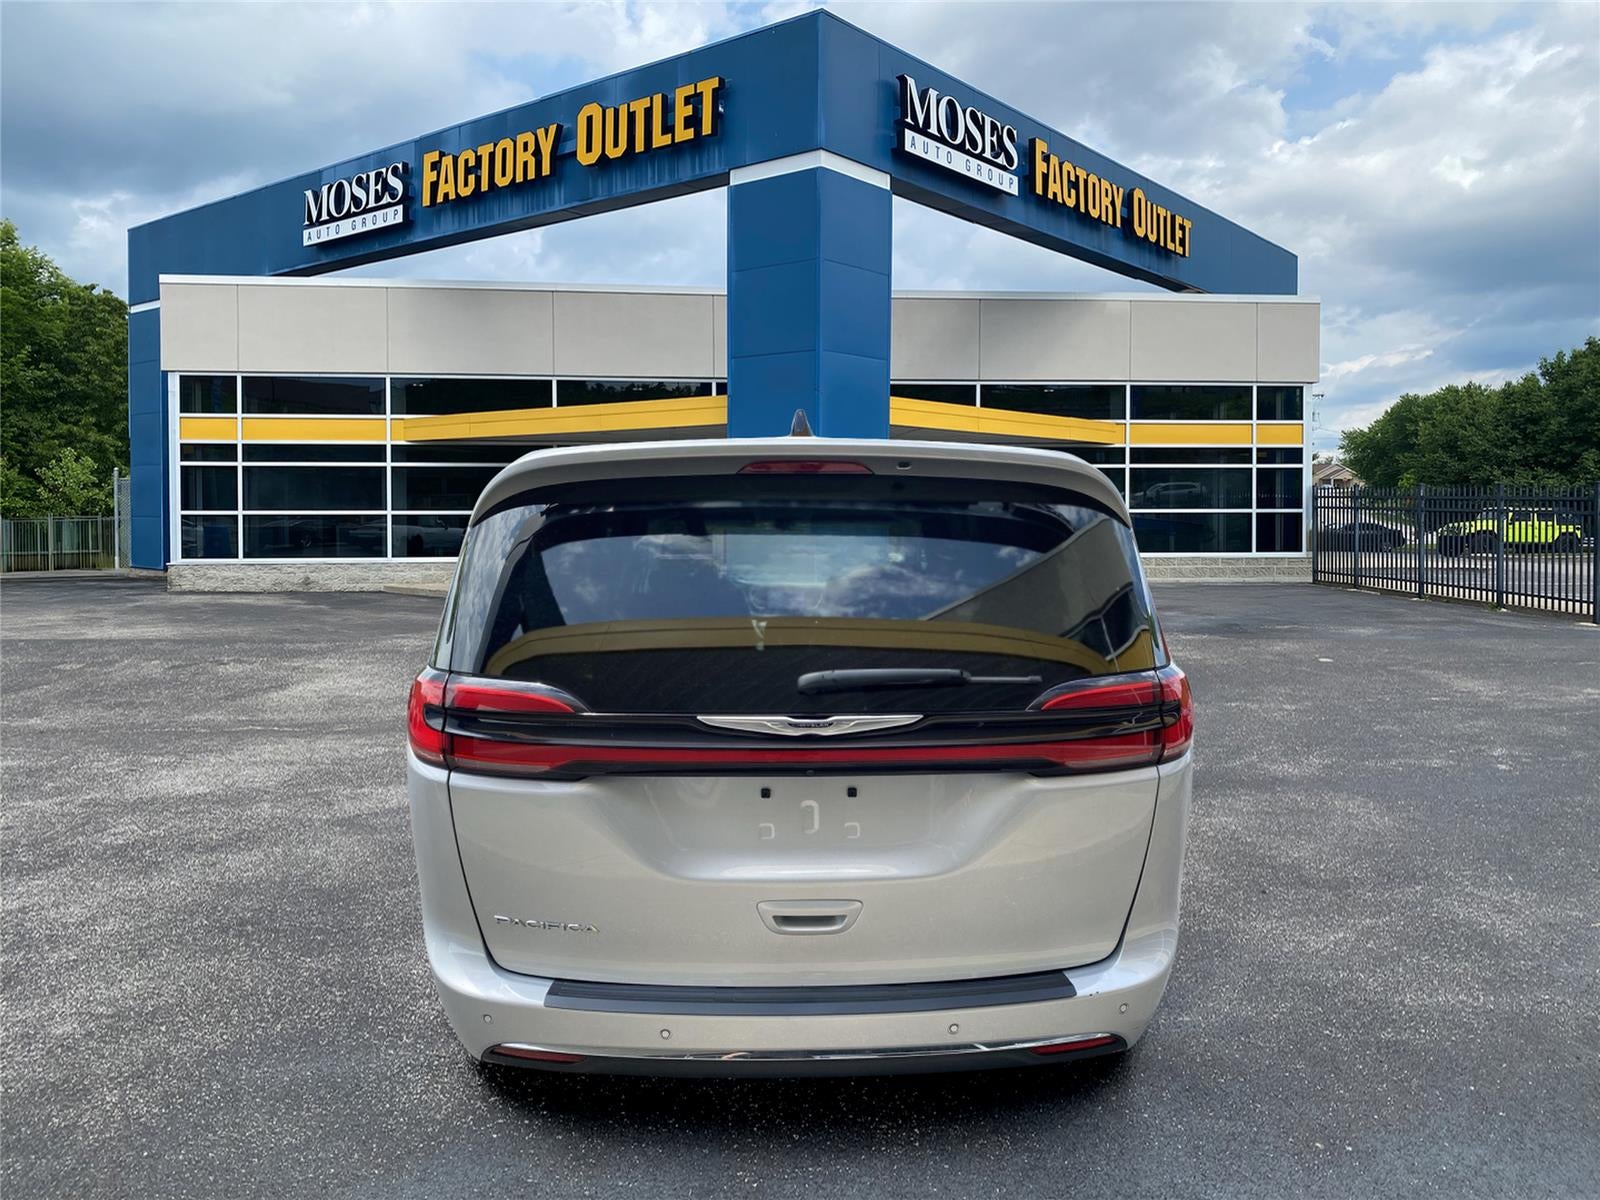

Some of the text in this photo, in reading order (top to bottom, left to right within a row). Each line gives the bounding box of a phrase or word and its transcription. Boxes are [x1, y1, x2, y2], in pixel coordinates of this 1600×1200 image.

[422, 76, 720, 208] FACTORY OUTLET
[904, 74, 1019, 171] MOSES
[303, 162, 404, 226] MOSES
[910, 135, 1014, 189] AUTO GROUP
[307, 208, 399, 242] AUTO GROUP
[1034, 137, 1192, 257] FACTORY OUTLET
[493, 914, 600, 932] PACIFICA
